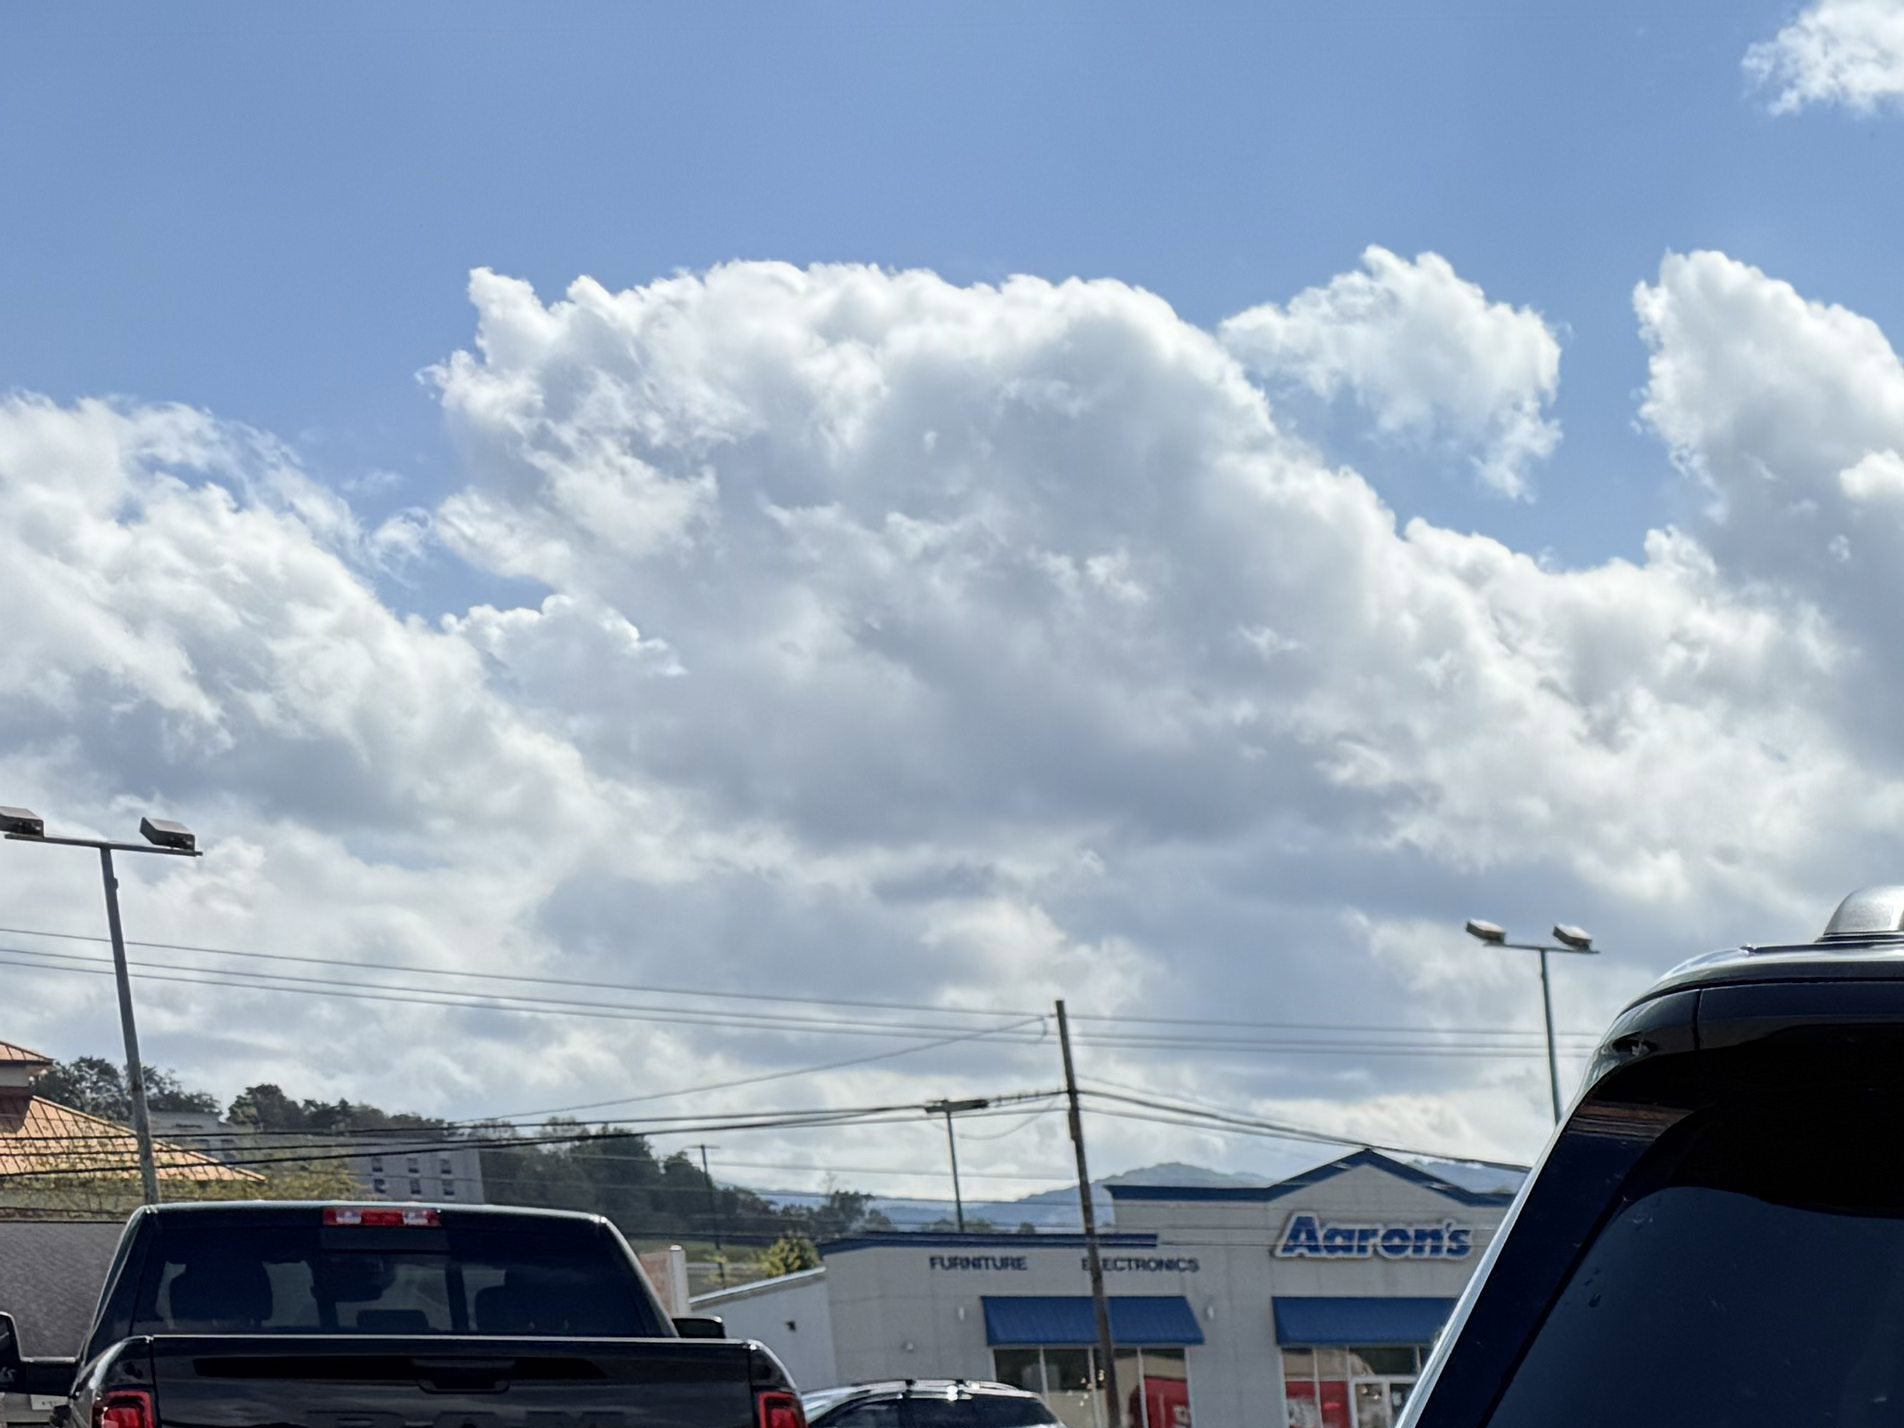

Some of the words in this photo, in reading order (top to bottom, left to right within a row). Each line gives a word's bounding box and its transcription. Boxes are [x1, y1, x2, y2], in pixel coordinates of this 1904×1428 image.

[1279, 1214, 1474, 1256] Aaron's
[929, 1255, 1028, 1272] FURNITURE
[1081, 1256, 1200, 1273] EECTRONICS
